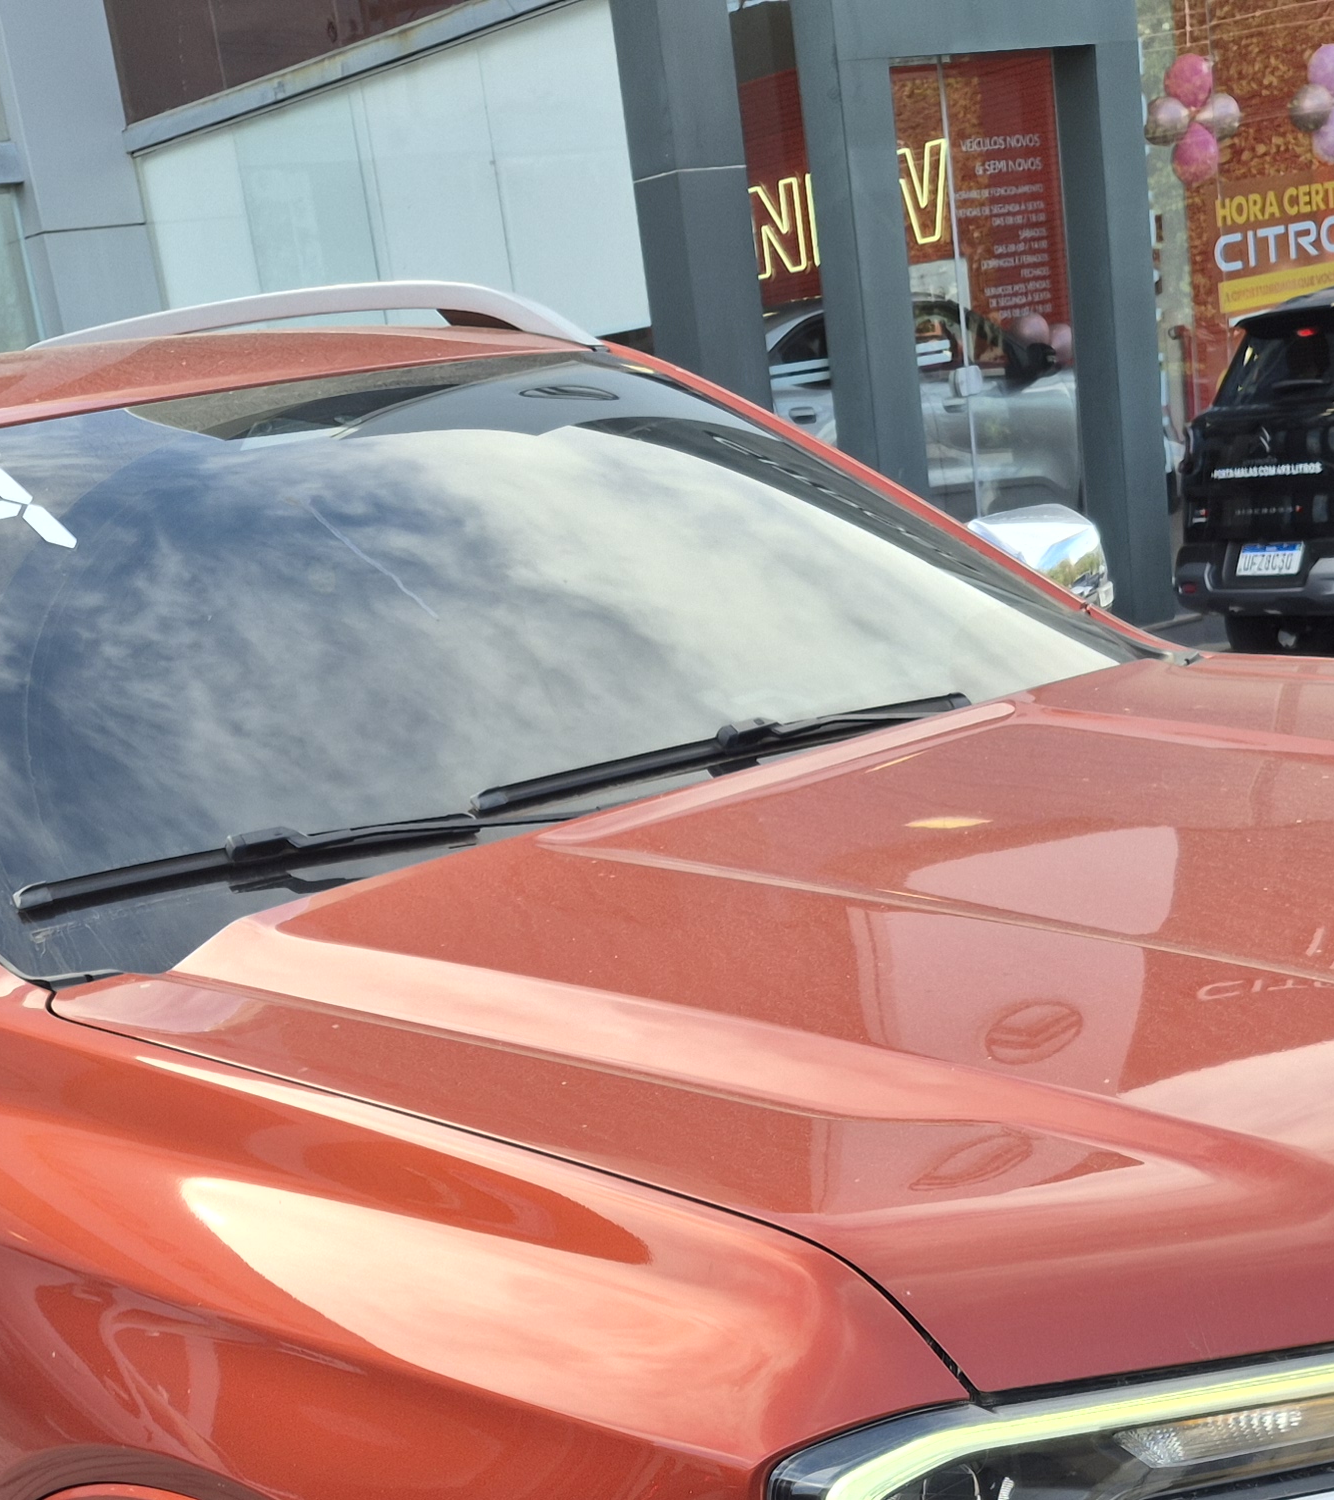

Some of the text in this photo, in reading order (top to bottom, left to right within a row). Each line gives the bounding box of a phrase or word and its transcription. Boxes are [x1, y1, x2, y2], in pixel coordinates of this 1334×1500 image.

[1006, 134, 1041, 148] NOVOS
[985, 160, 1007, 174] SEMI
[1008, 158, 1042, 172] NOVOS
[1215, 190, 1280, 227] HORA
